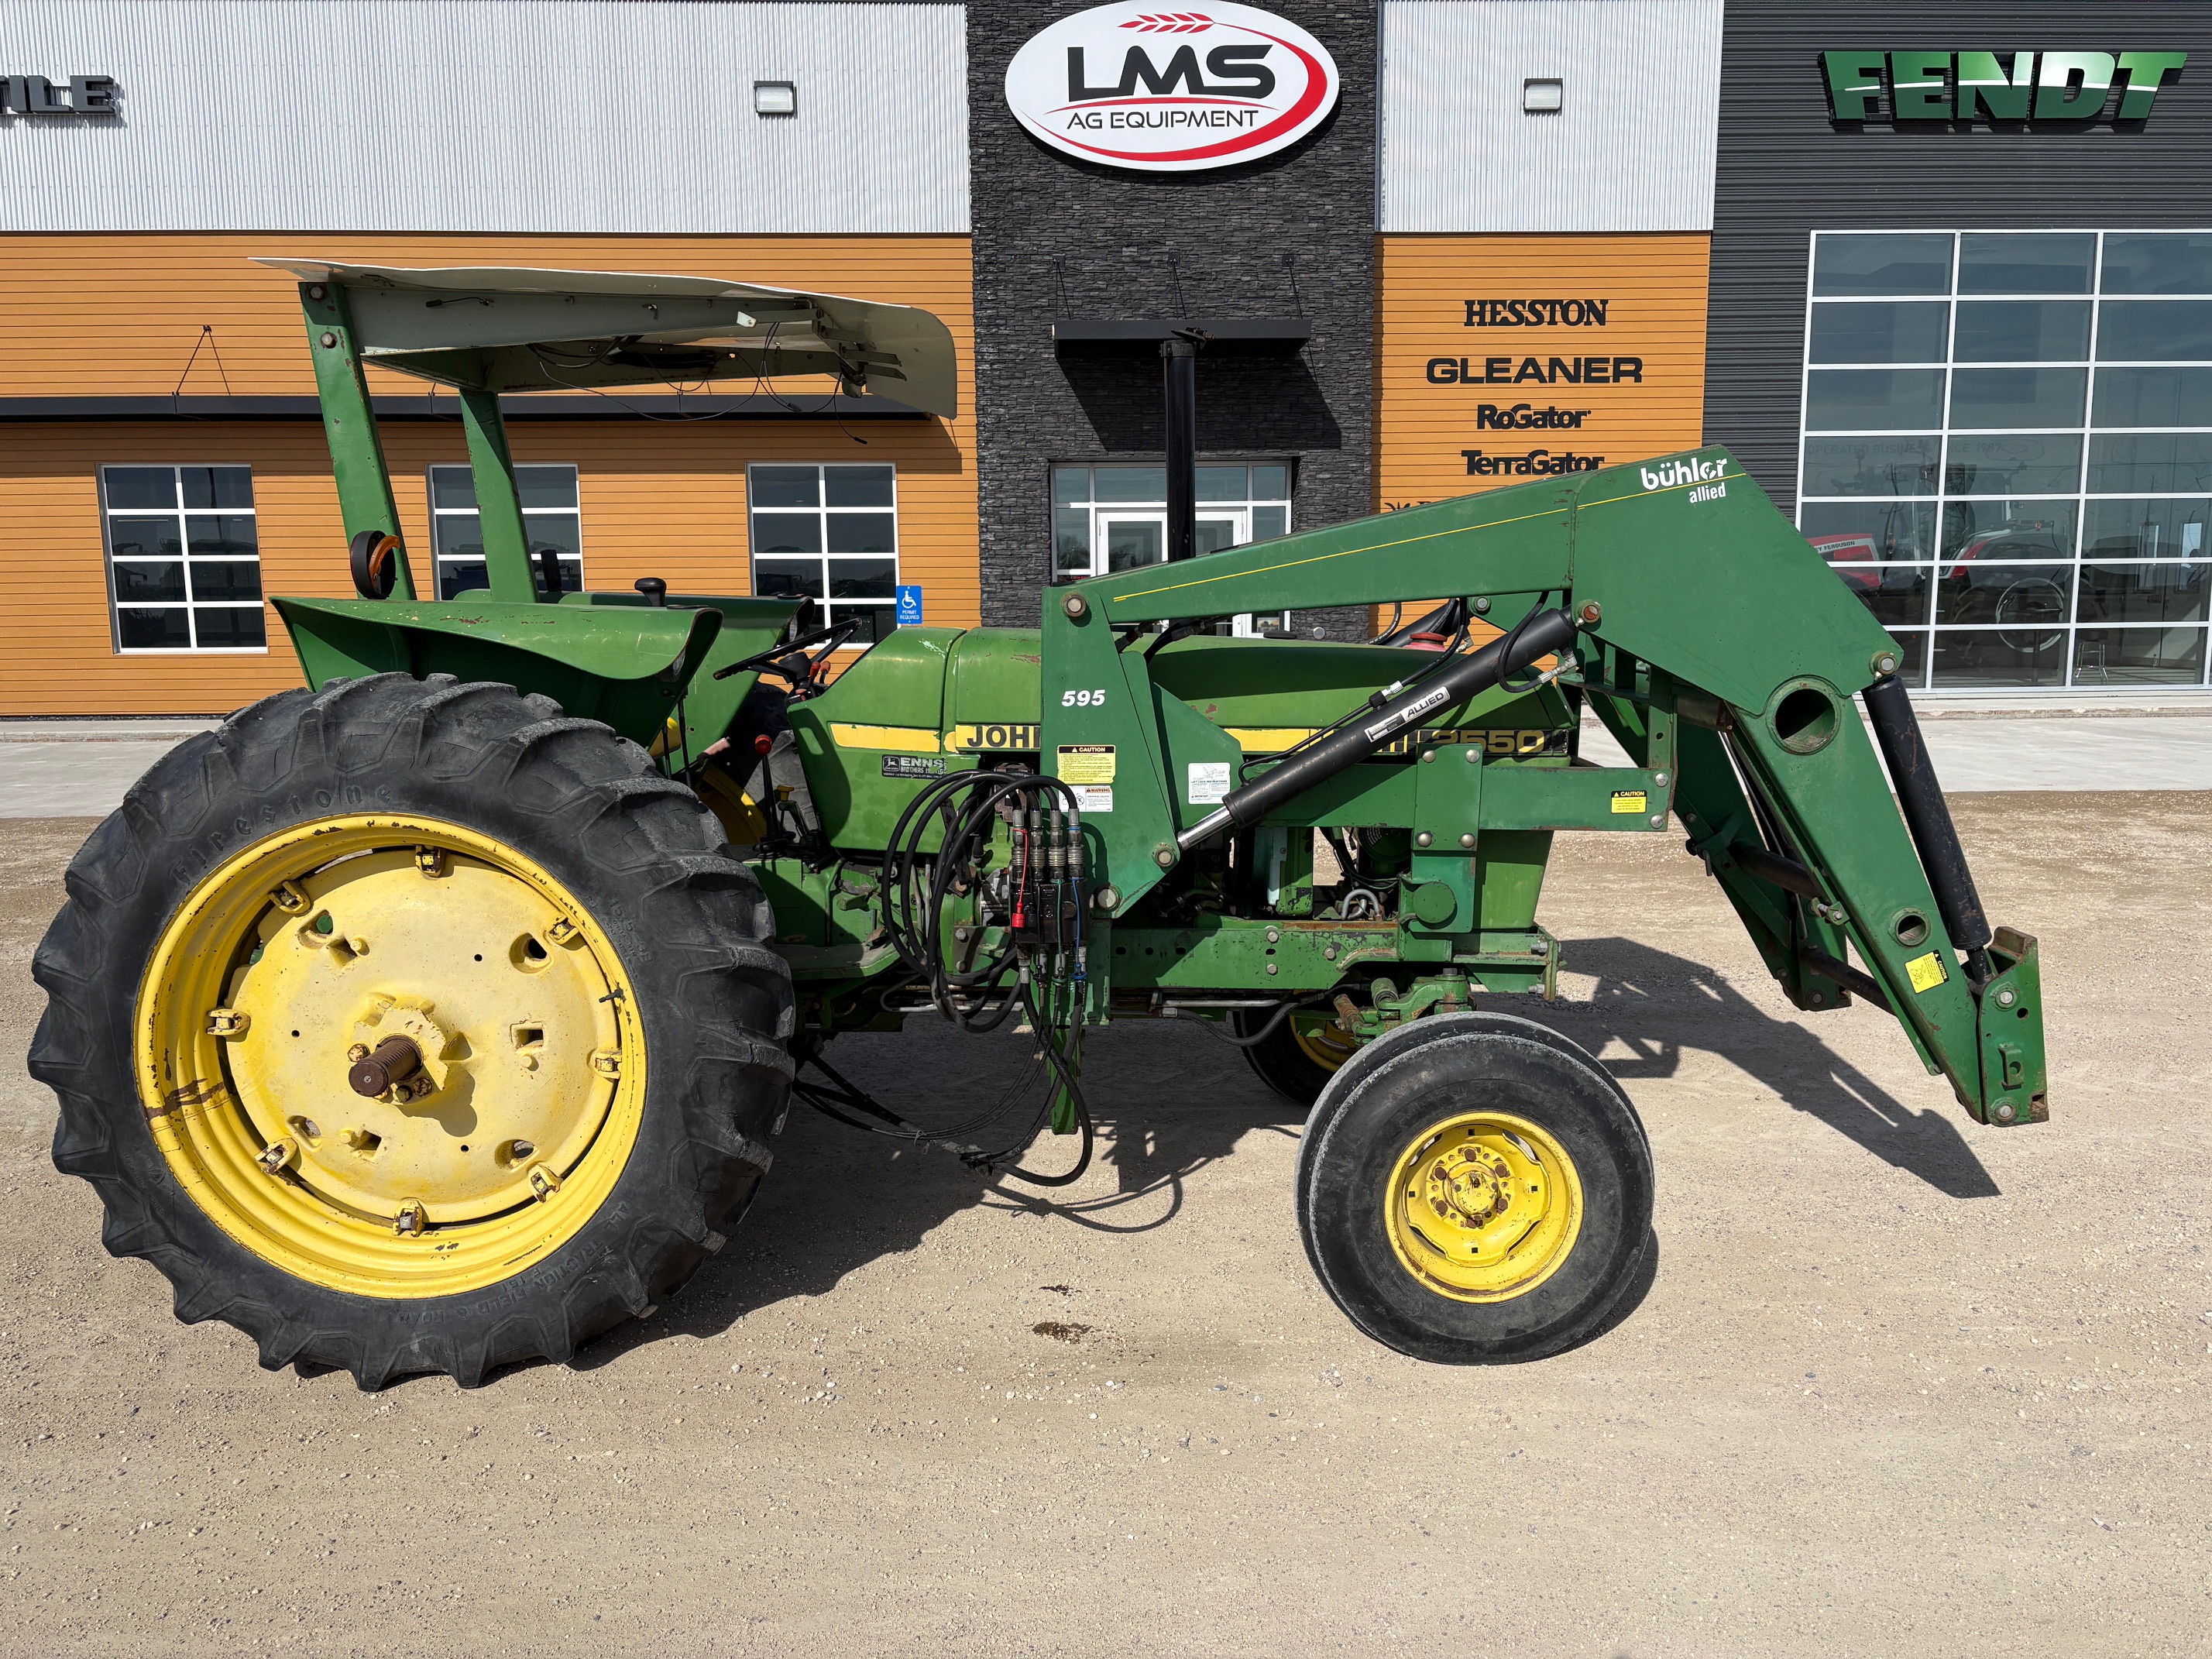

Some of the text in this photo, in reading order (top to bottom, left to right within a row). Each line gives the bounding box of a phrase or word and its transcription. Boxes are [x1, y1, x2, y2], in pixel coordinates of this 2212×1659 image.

[1067, 44, 1276, 102] LMS
[1822, 50, 2188, 120] FENDT
[0, 74, 114, 112] ILE
[1066, 110, 1259, 130] AG EQUIPMENT
[1464, 299, 1609, 326] HESSTON
[1426, 357, 1643, 383] GLEANER
[1476, 404, 1592, 429] RoGator
[1461, 449, 1605, 476] TerraGator
[1640, 457, 1728, 490] bühler
[1689, 482, 1726, 503] allied
[1824, 541, 1855, 551] FERGUSON
[1061, 689, 1106, 707] 595
[1407, 692, 1444, 718] ALLIED
[1432, 729, 1545, 753] 2550
[900, 757, 944, 768] ENNS
[1937, 960, 1948, 980] CAUTION
[477, 1288, 527, 1314] FIELD
